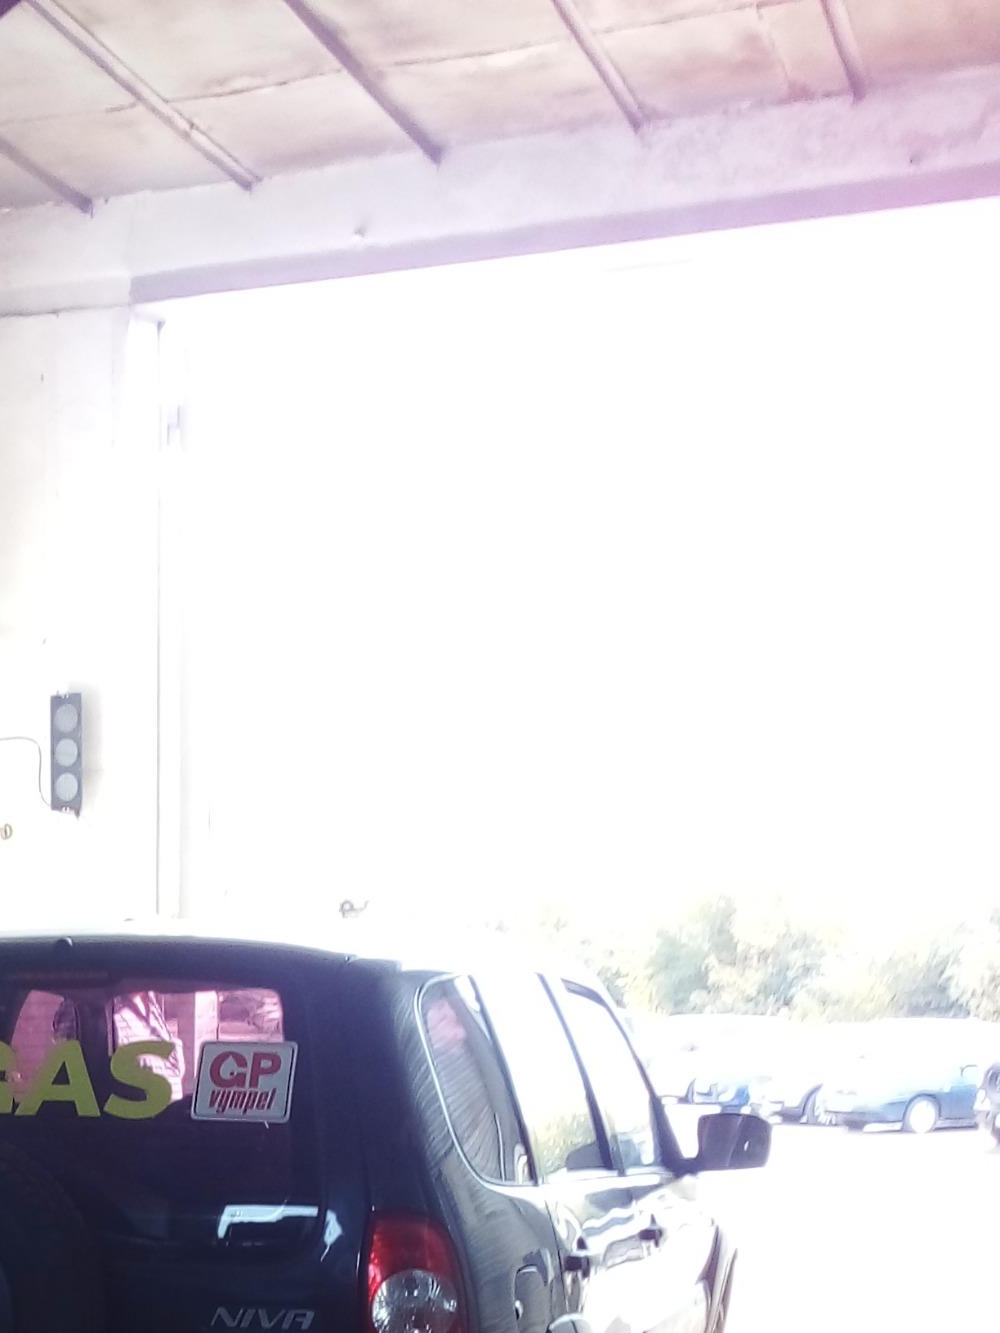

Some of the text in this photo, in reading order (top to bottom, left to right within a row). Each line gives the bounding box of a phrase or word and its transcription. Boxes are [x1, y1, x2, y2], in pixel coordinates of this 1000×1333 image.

[209, 1051, 282, 1089] GP
[208, 1087, 278, 1116] vympel
[209, 1306, 316, 1330] NIVA
